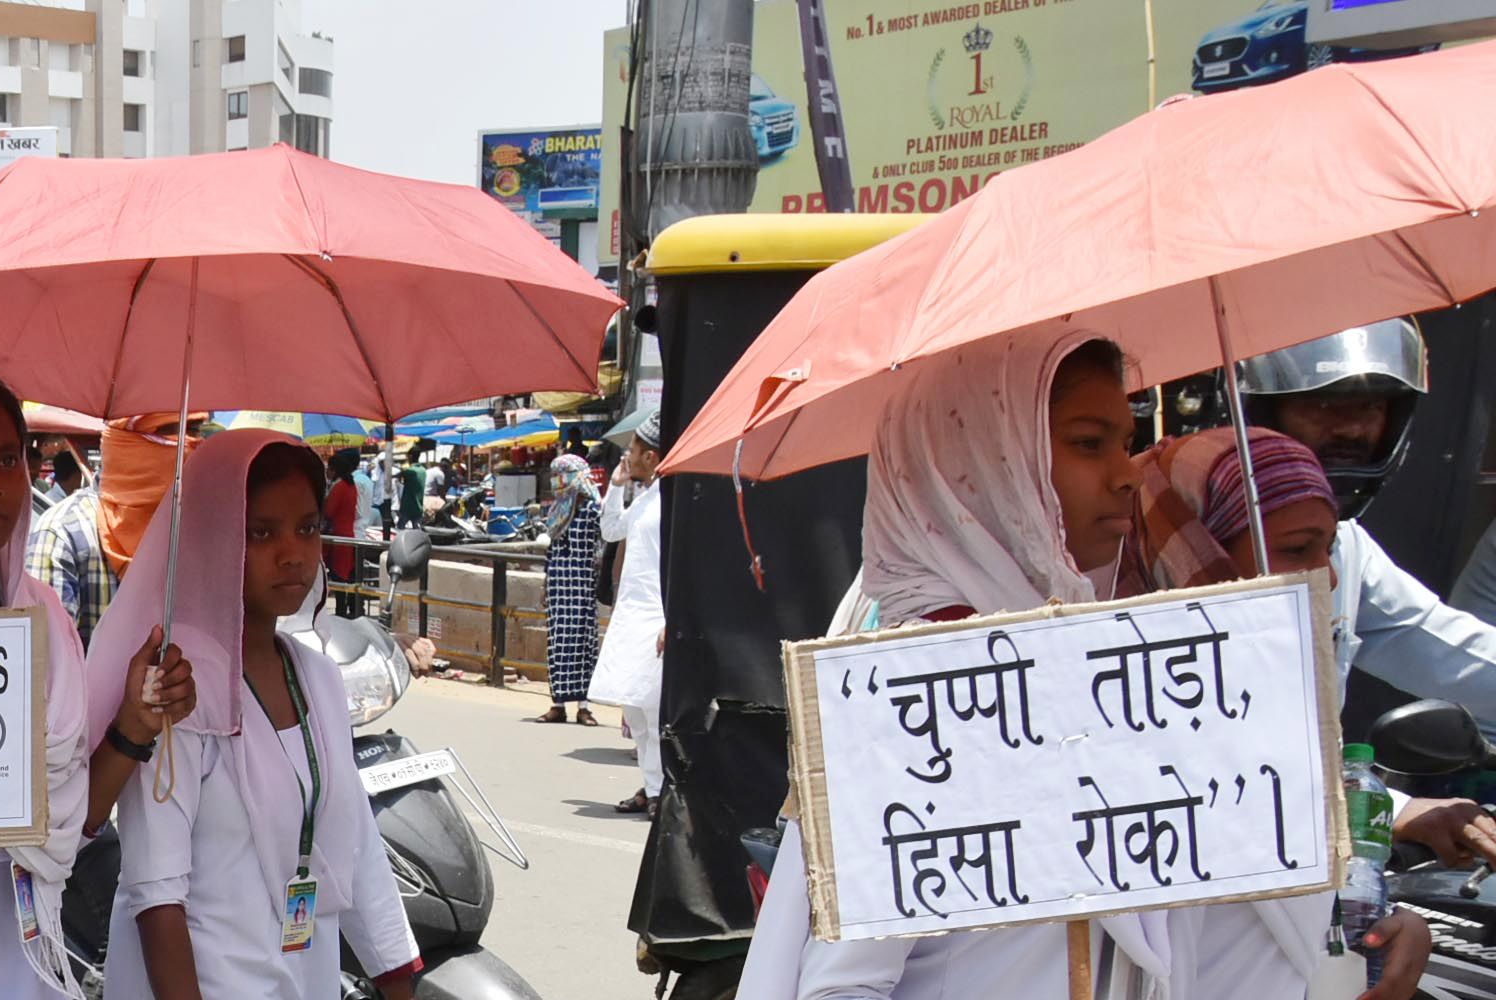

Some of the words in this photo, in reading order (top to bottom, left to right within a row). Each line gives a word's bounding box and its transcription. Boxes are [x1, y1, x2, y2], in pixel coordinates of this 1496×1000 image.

[887, 14, 918, 34] MOST
[922, 4, 980, 28] AWARDED
[984, 0, 1030, 16] DEALER
[949, 101, 1008, 128] ROYAL
[7, 137, 41, 150] खबर
[906, 129, 983, 155] PLATINUM
[988, 121, 1049, 145] DEALER
[566, 153, 585, 162] THE
[872, 166, 880, 179] &
[882, 163, 907, 178] ONLY
[909, 159, 937, 175] CLUB
[938, 156, 959, 173] 500
[962, 152, 1000, 168] DEALER
[1004, 150, 1018, 164] OF
[1021, 147, 1041, 162] THE
[781, 171, 1002, 213] PRMSON
[357, 744, 385, 760] HON
[882, 801, 1030, 919] हिंसा
